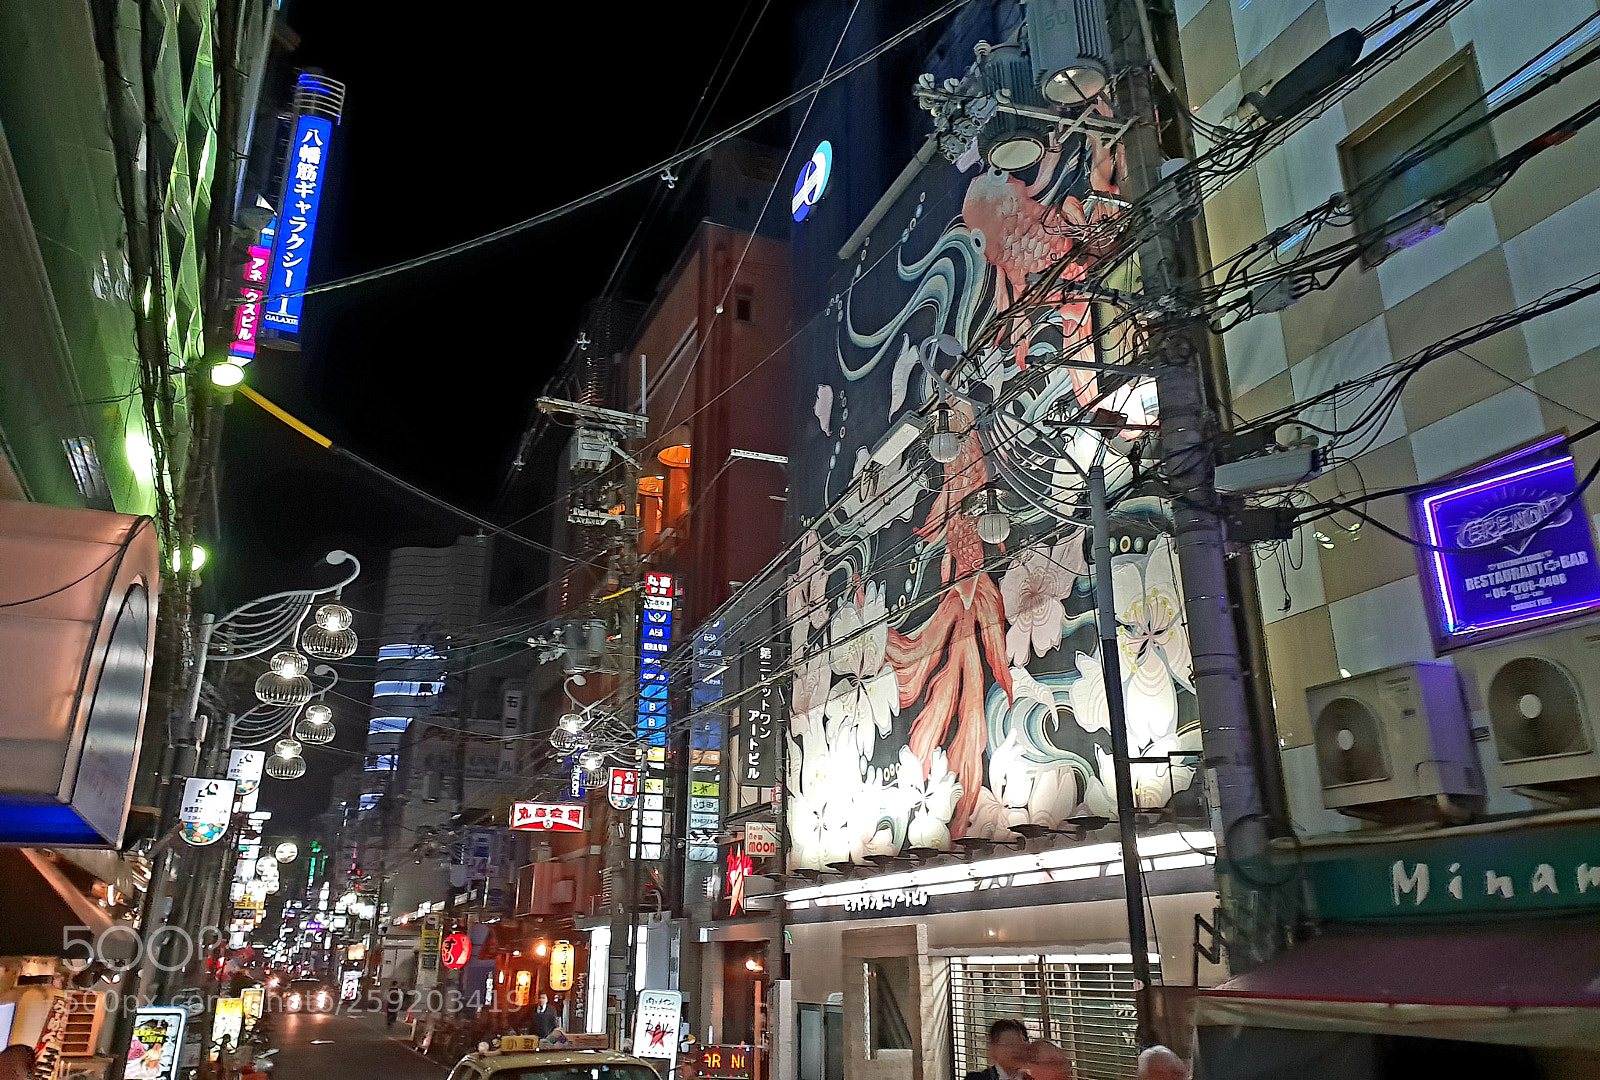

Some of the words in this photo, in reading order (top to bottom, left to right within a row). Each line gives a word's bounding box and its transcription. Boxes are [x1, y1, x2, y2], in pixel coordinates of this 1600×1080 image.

[1464, 561, 1545, 591] RESTAURANT
[1559, 550, 1589, 569] BAR
[748, 709, 760, 780] アートビル
